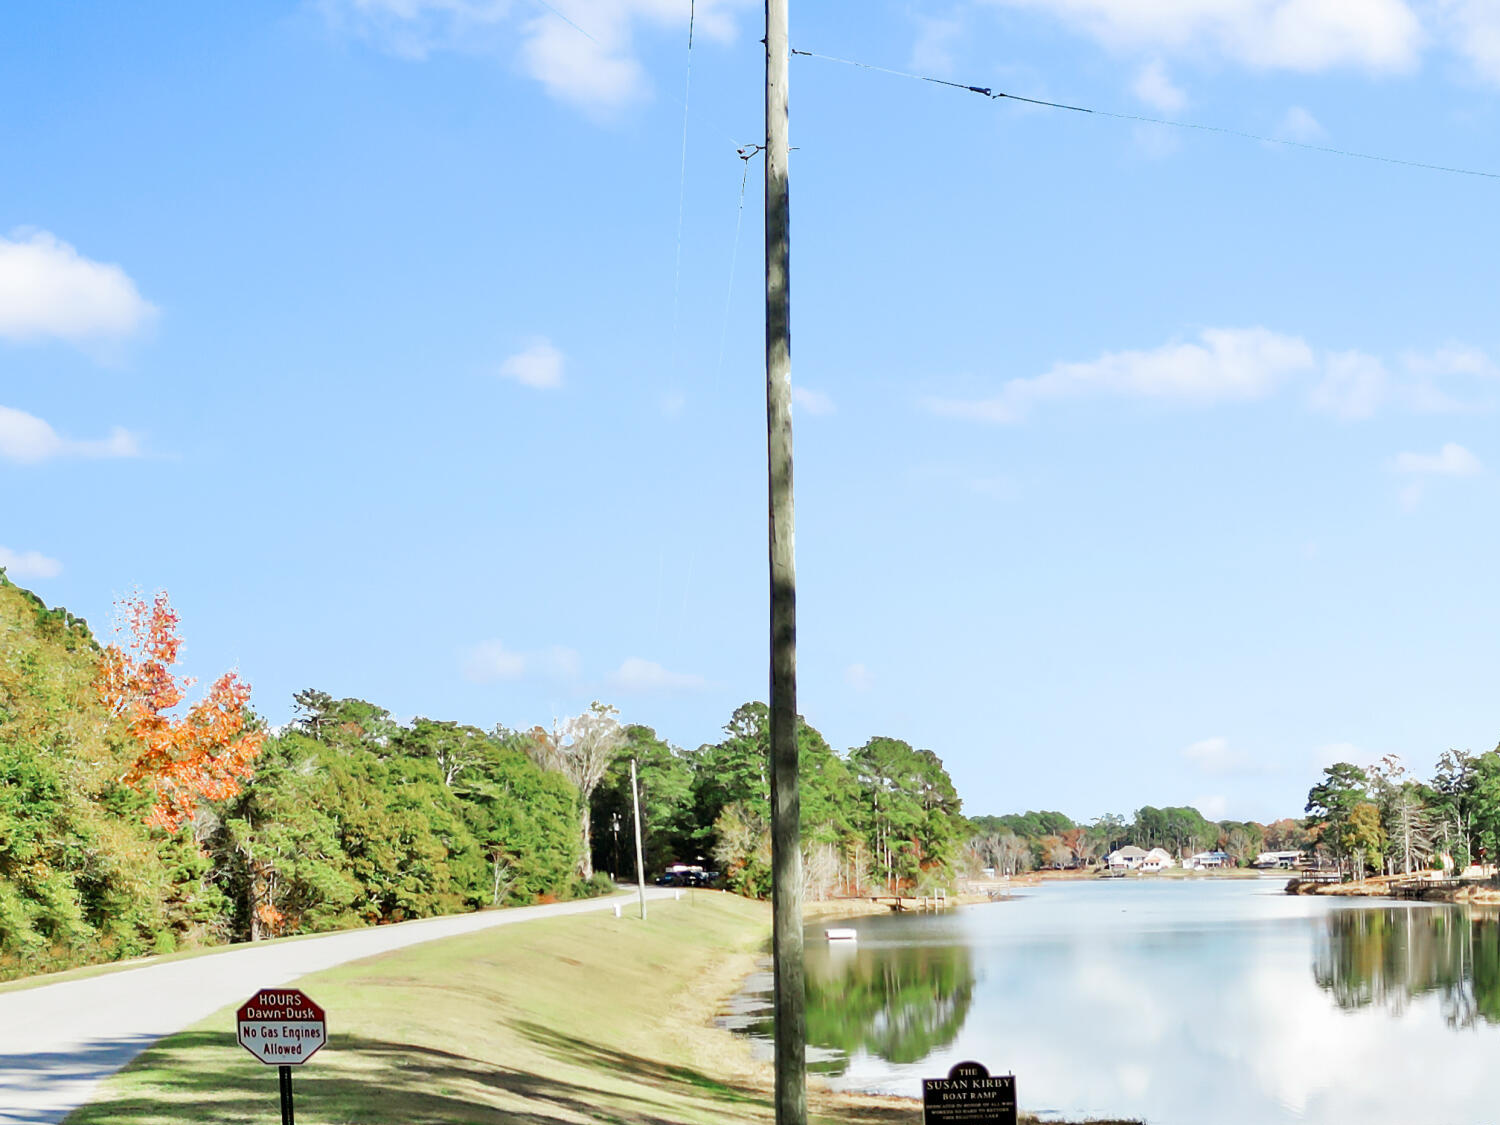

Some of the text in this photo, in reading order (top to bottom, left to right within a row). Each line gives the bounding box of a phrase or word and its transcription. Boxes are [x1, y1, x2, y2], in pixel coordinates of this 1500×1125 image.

[259, 994, 302, 1006] HOURS
[247, 1007, 315, 1019] Dawn-Dusk
[243, 1026, 321, 1041] No Gas Engines
[263, 1043, 302, 1055] Allowed
[959, 1068, 978, 1076] THE
[926, 1078, 1011, 1090] SUSAN KIRBY
[942, 1091, 997, 1100] BOAT RAMP
